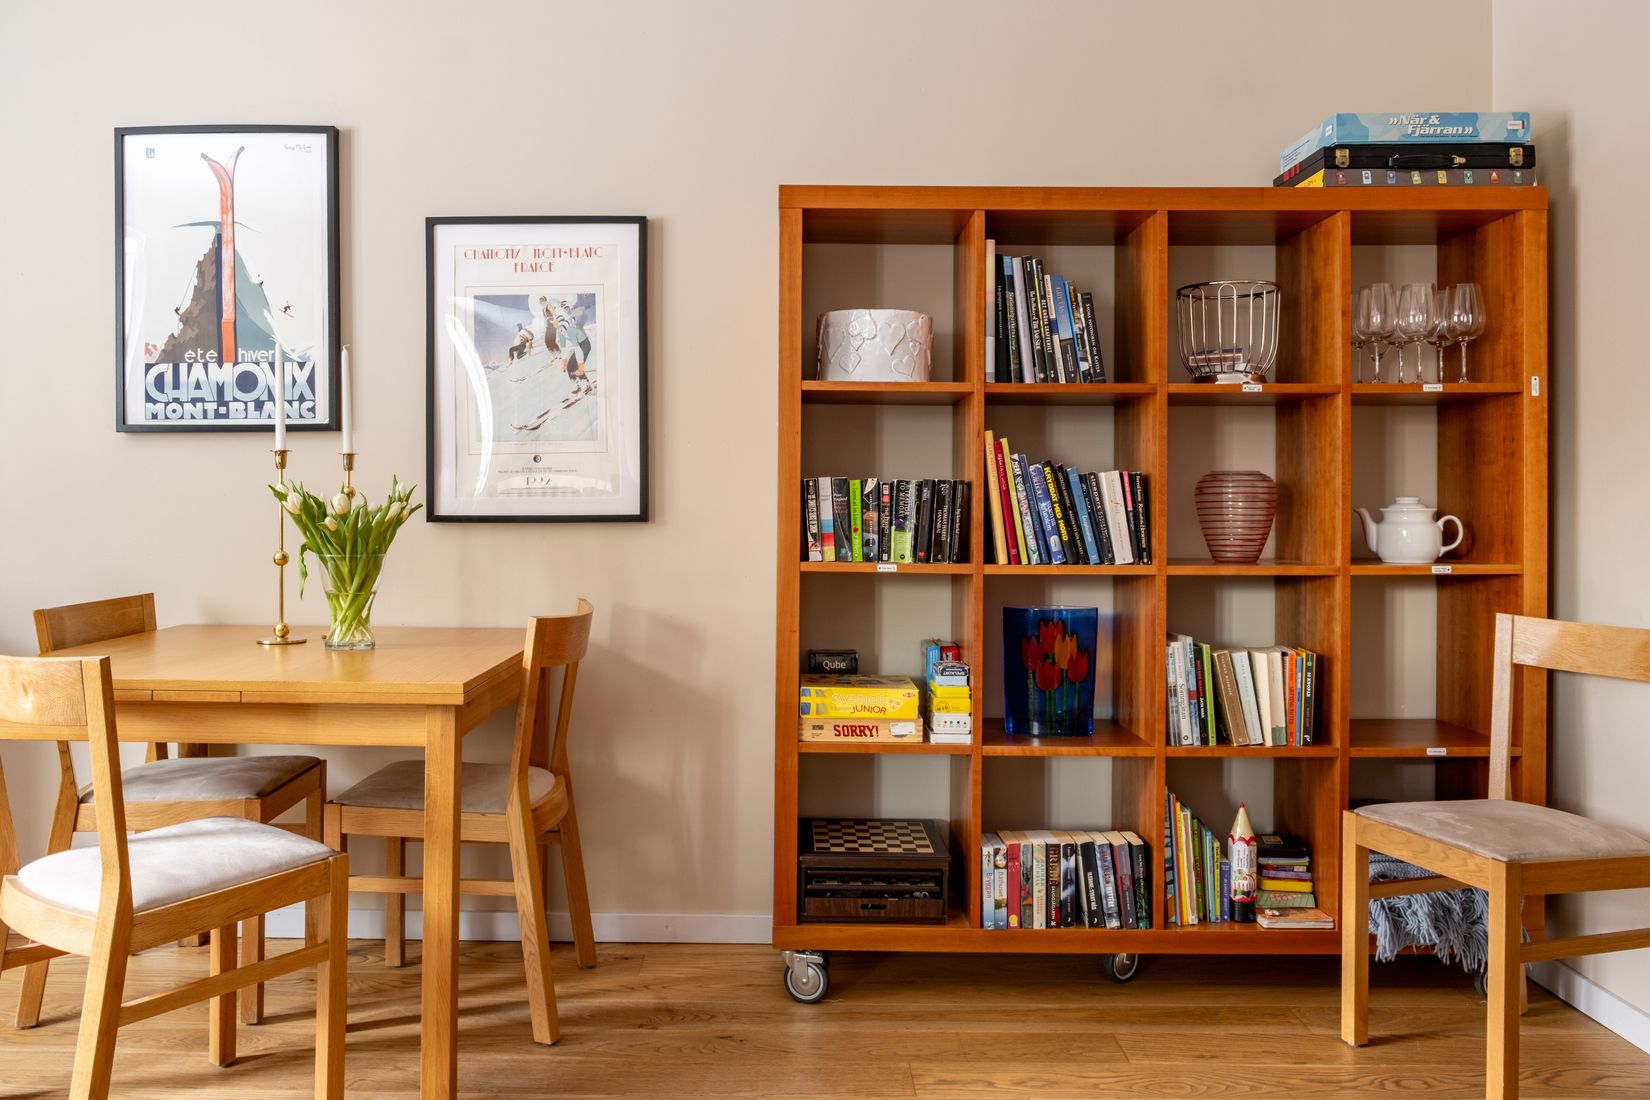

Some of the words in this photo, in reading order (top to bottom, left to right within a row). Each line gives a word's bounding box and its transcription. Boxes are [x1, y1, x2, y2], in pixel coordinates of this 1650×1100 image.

[1429, 115, 1440, 124] &
[514, 262, 555, 273] FRANCE
[238, 348, 275, 362] hiver
[146, 362, 315, 402] CHAMONIX
[145, 401, 315, 419] MONT-BLANC
[899, 481, 905, 490] TO
[1043, 466, 1058, 502] KRYDDAT
[1089, 474, 1102, 509] sleepers
[1053, 502, 1062, 519] MED
[1057, 519, 1069, 541] MORD
[823, 660, 847, 670] Qube
[850, 705, 887, 715] JUNIOR
[833, 724, 879, 737] SORRY!
[984, 872, 992, 898] Bryggan
